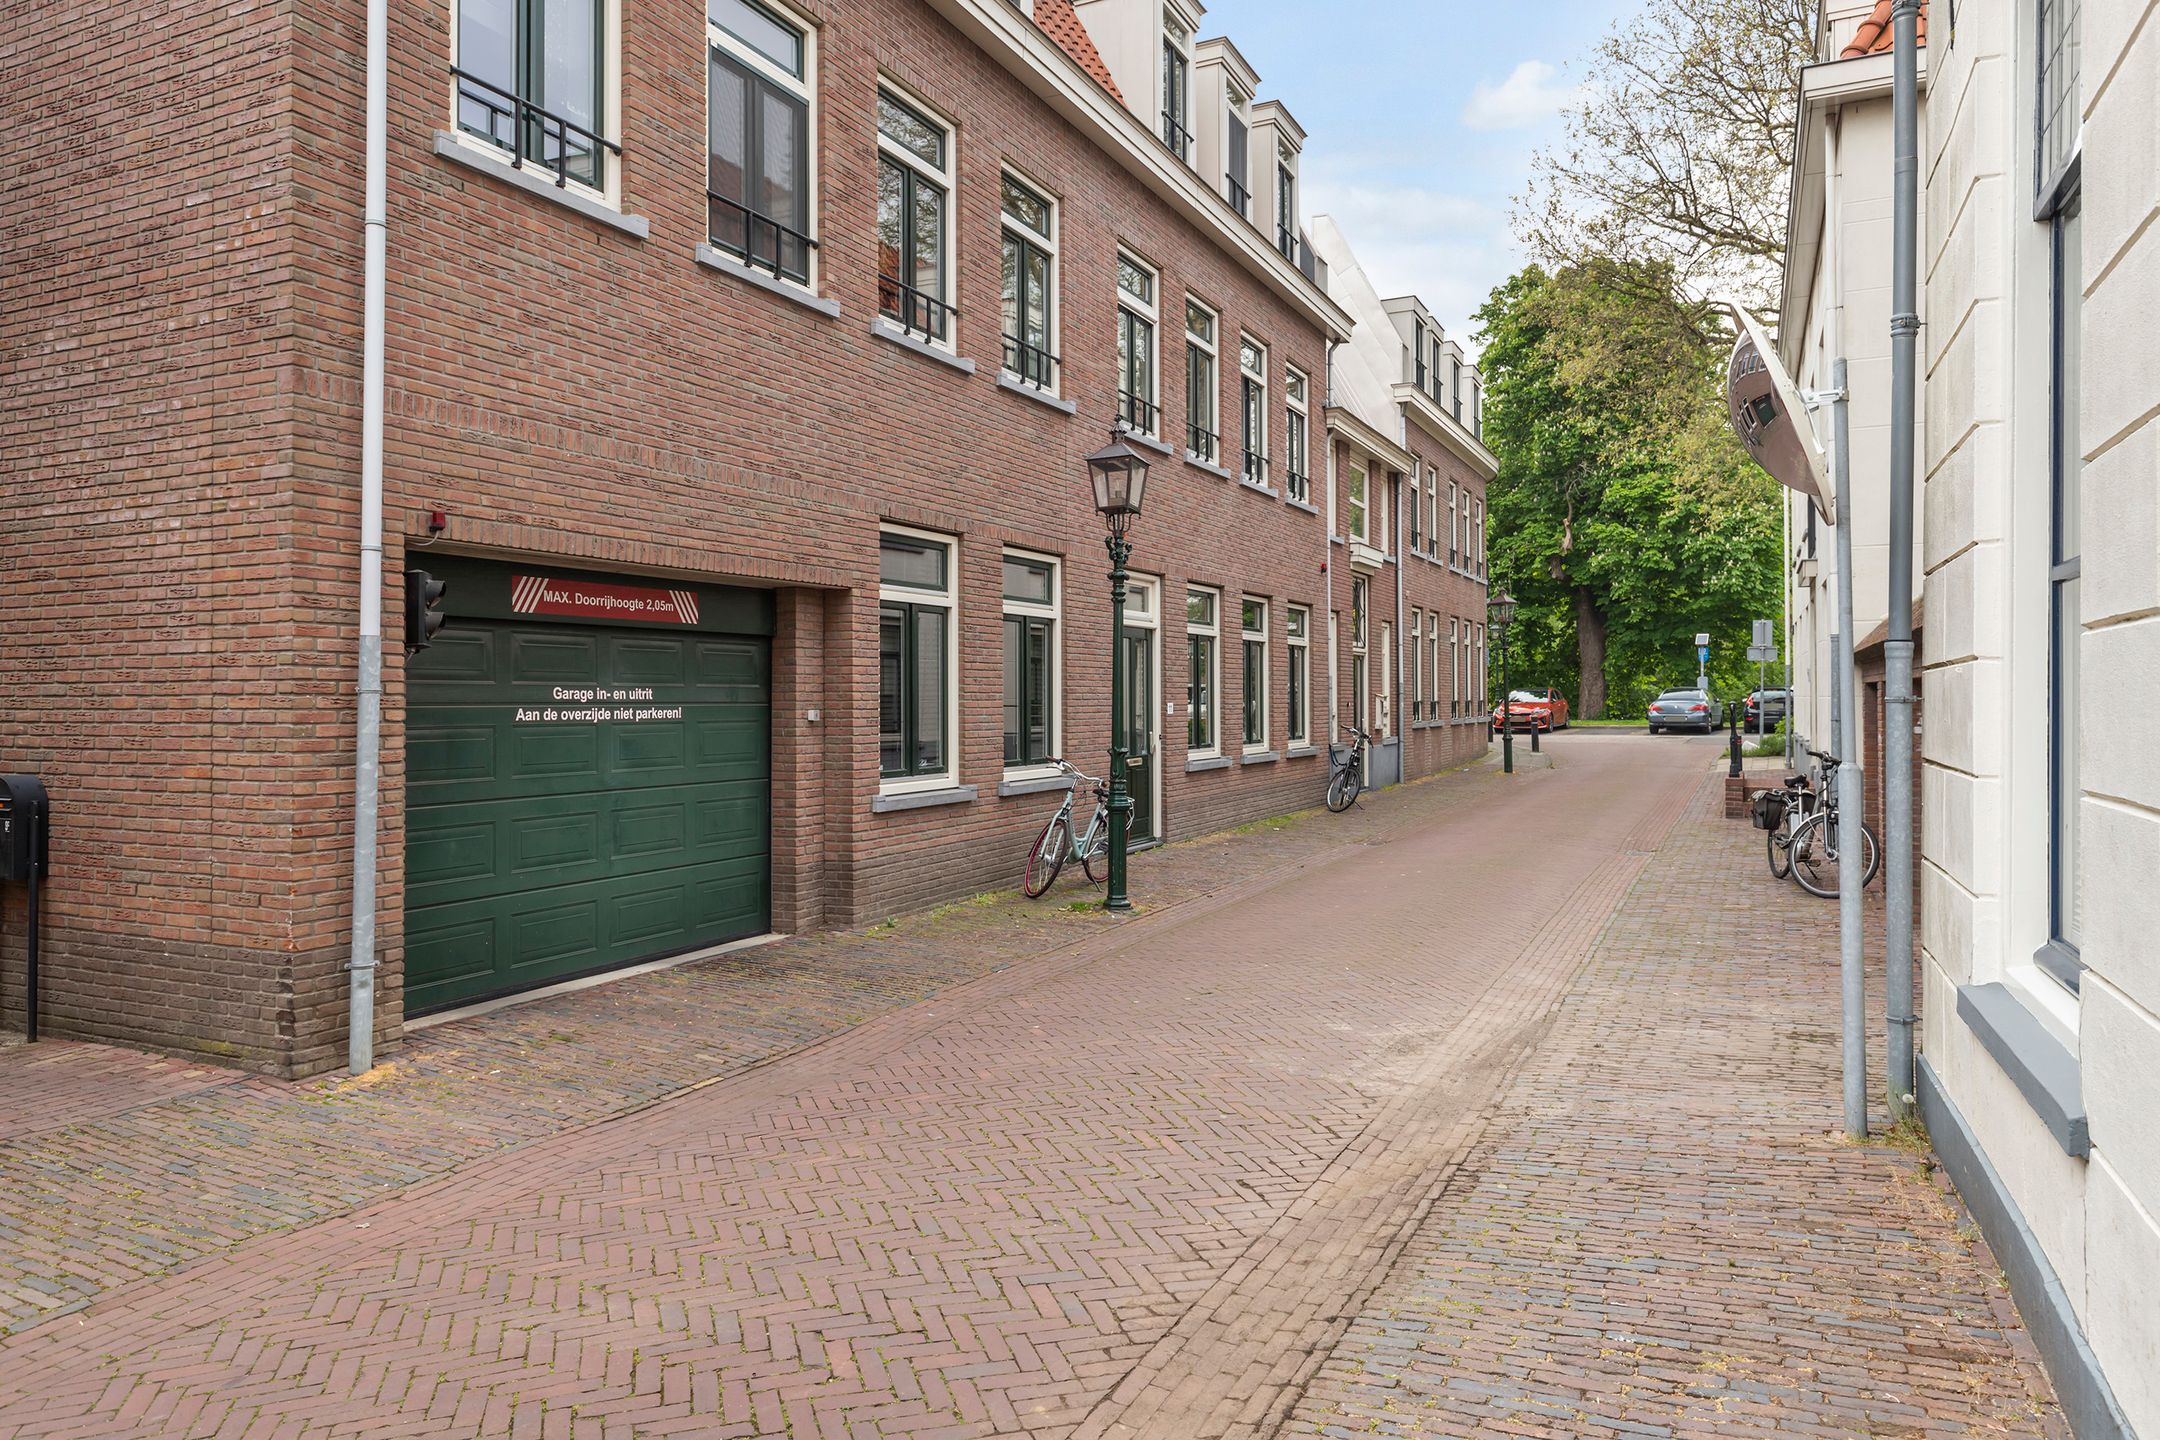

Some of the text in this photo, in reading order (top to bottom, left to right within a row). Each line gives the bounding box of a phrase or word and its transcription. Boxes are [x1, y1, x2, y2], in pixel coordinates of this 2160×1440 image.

[543, 590, 674, 612] MAX. Doorrijhoogte 2,05m
[553, 687, 653, 702] Garage in- en uitrit
[515, 707, 682, 723] Aan de overzijde niet parkeren!
